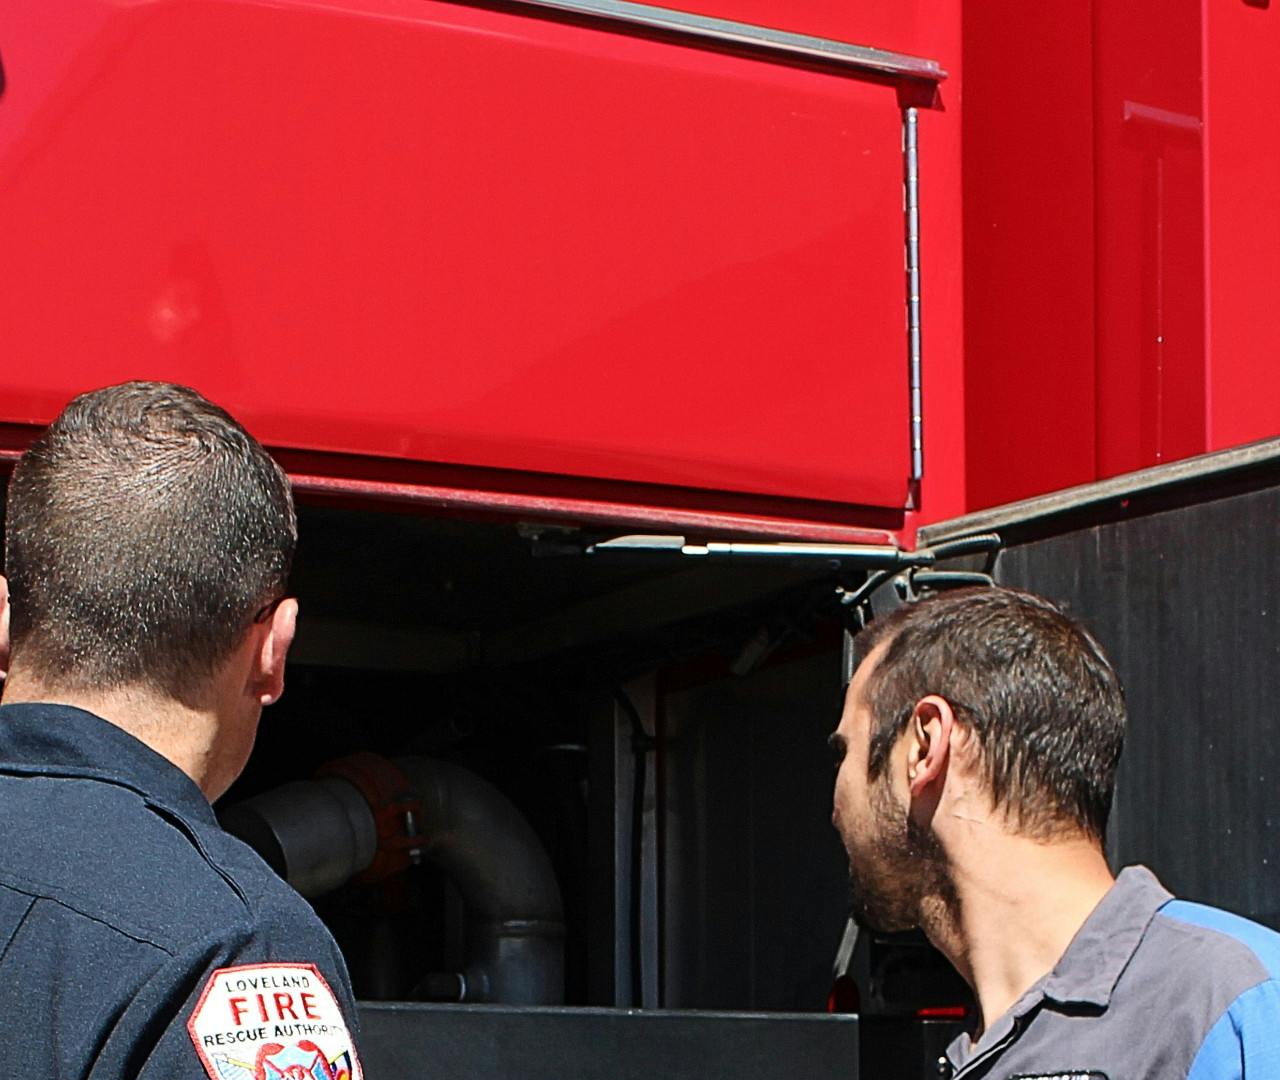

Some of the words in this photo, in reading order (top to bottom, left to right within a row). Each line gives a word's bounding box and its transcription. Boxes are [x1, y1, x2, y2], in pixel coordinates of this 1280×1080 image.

[226, 975, 310, 993] LOVELAND
[228, 992, 321, 1026] FIRE
[204, 1027, 266, 1048] RESCUE
